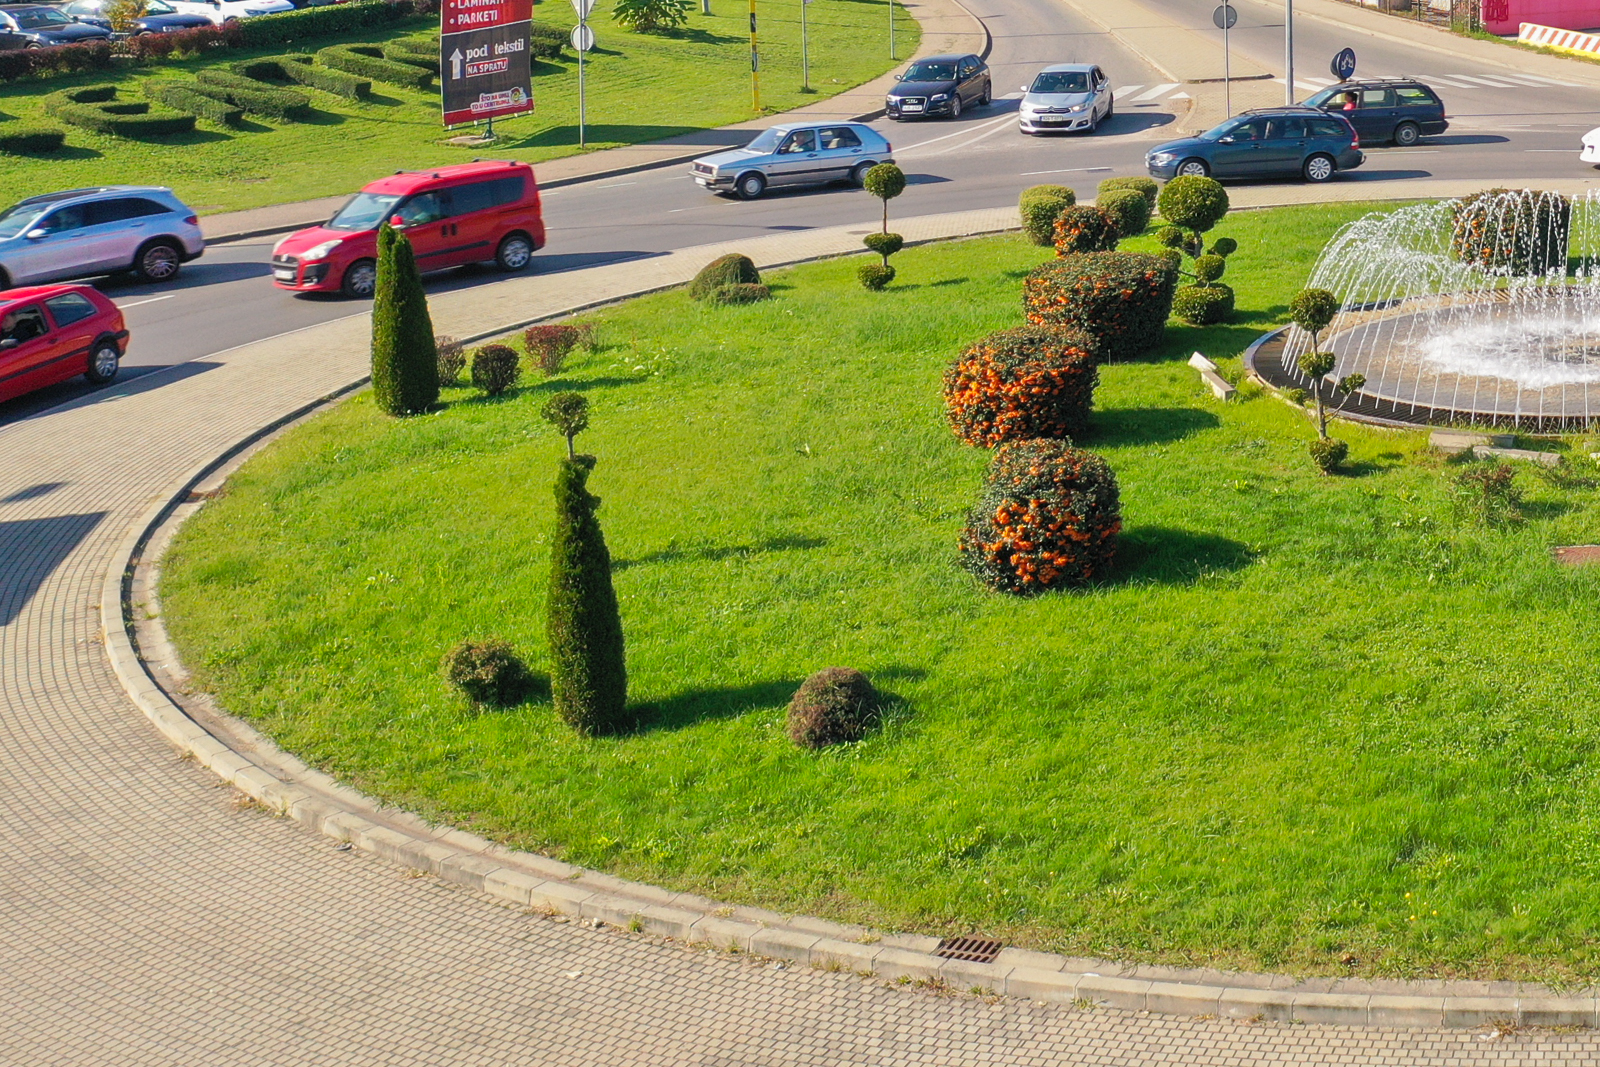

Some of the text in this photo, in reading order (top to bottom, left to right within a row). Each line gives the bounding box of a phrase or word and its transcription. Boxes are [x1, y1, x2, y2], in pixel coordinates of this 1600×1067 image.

[457, 10, 498, 25] PARKETI
[466, 38, 524, 62] pod tekstil
[468, 61, 506, 74] NA SPRATU
